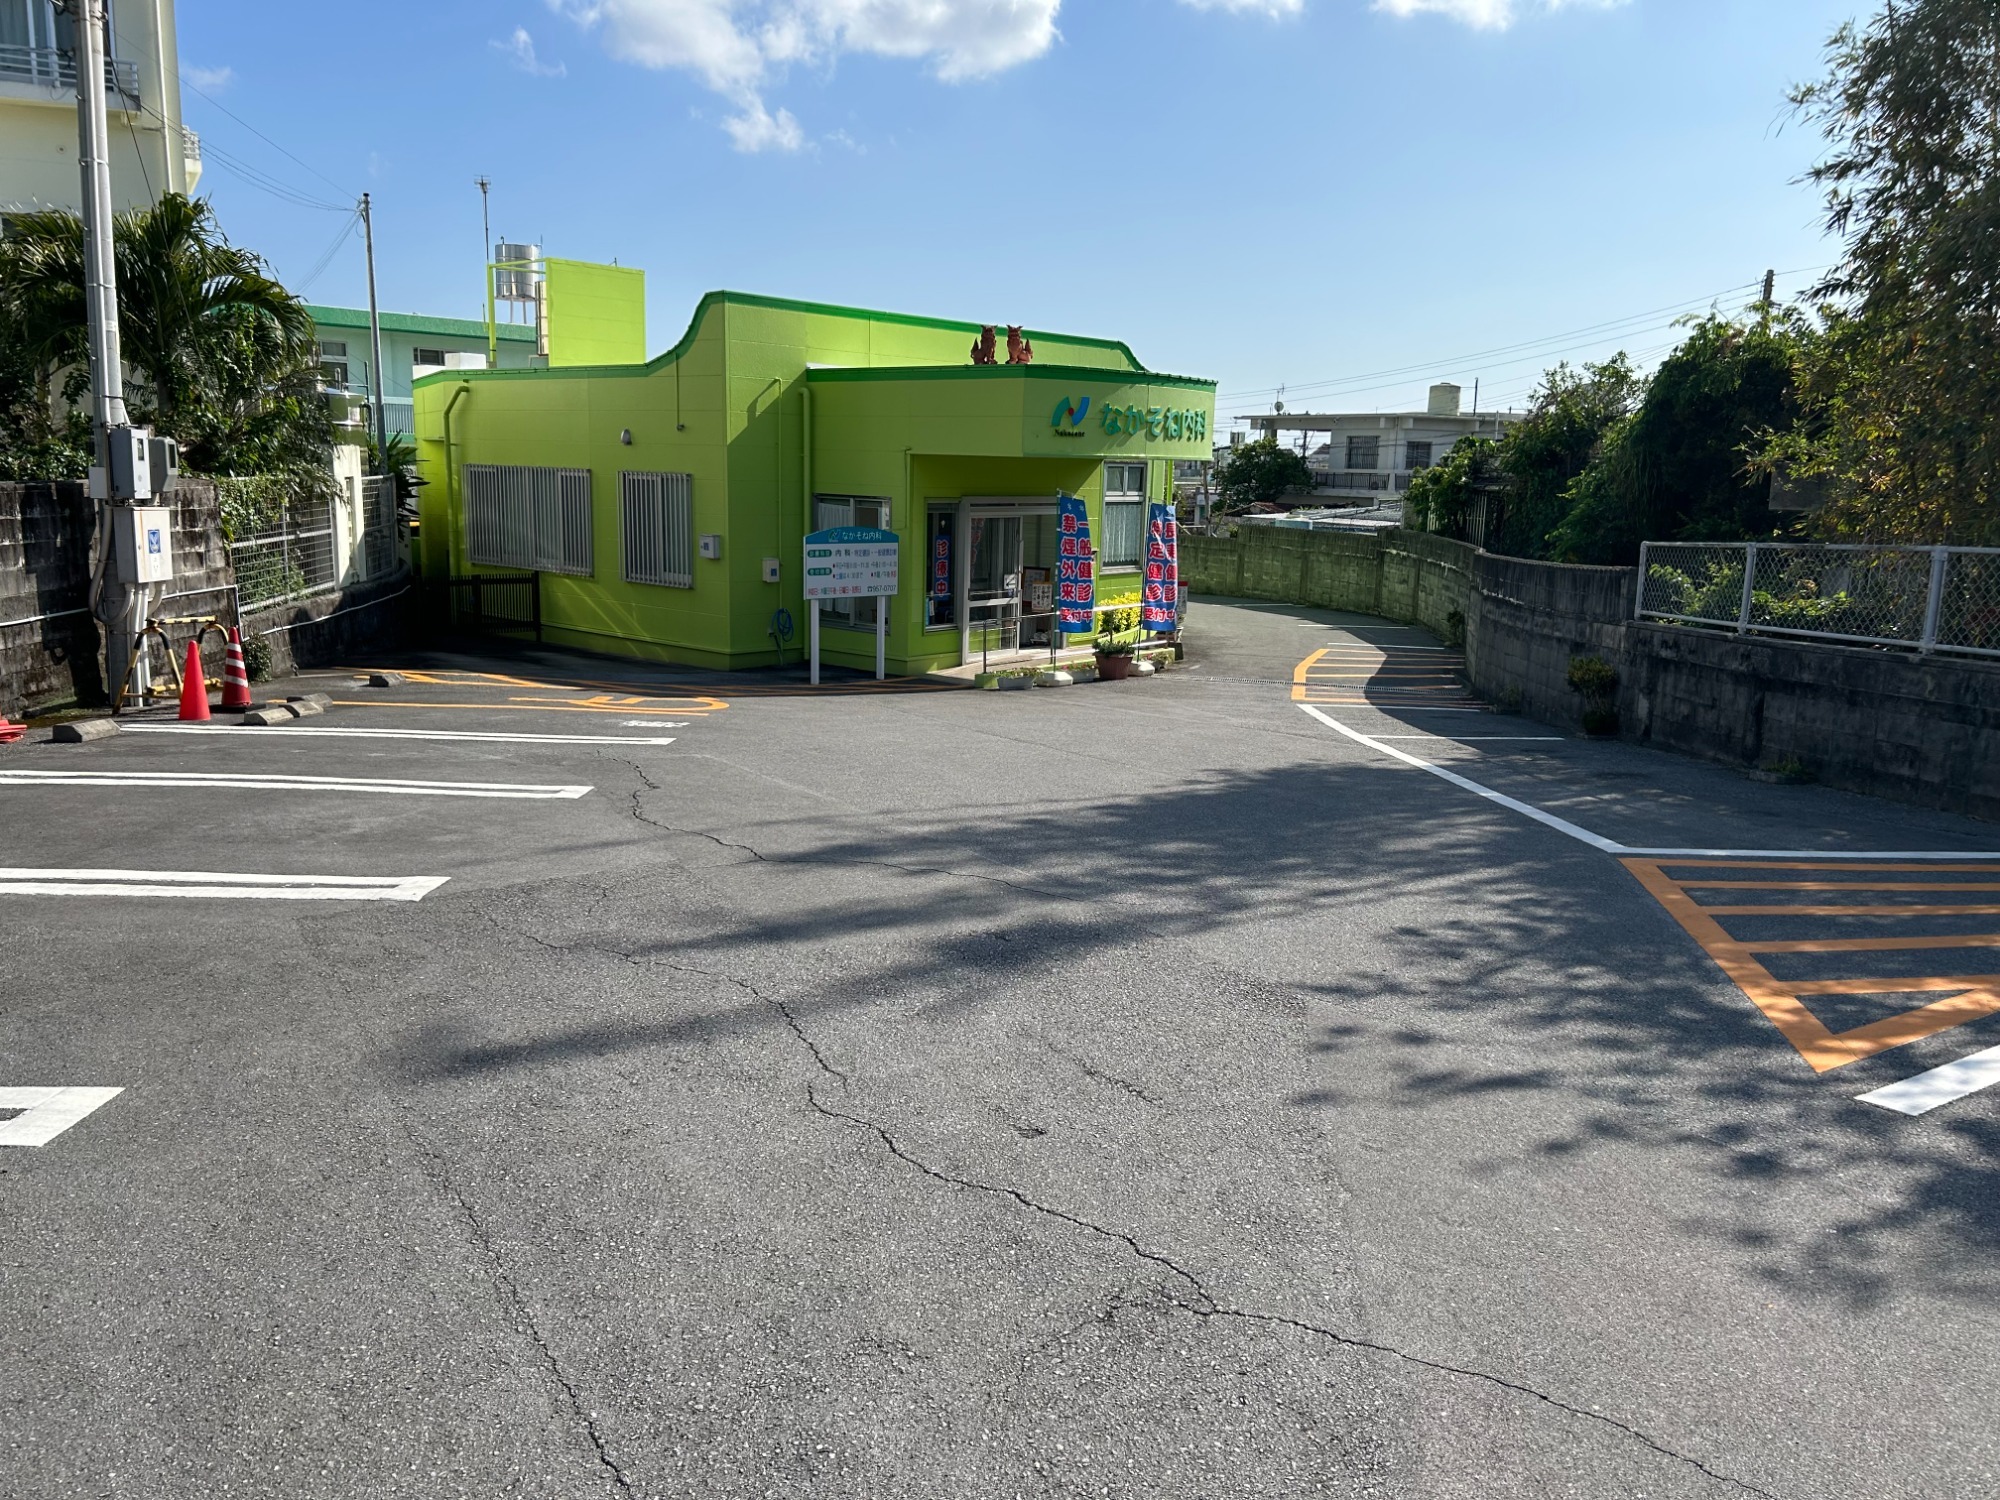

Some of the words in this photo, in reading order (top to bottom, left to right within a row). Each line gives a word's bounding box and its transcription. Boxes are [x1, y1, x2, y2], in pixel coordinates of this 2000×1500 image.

[1101, 402, 1206, 440] なかそね内科
[842, 531, 882, 541] なかそね内科
[1061, 513, 1077, 602] 禁煙外来
[935, 539, 949, 597] 診療中
[1077, 520, 1092, 603] 一般健診
[1146, 520, 1164, 602] 特定健診
[1060, 607, 1092, 623] 受付中
[1143, 606, 1175, 622] 受付中
